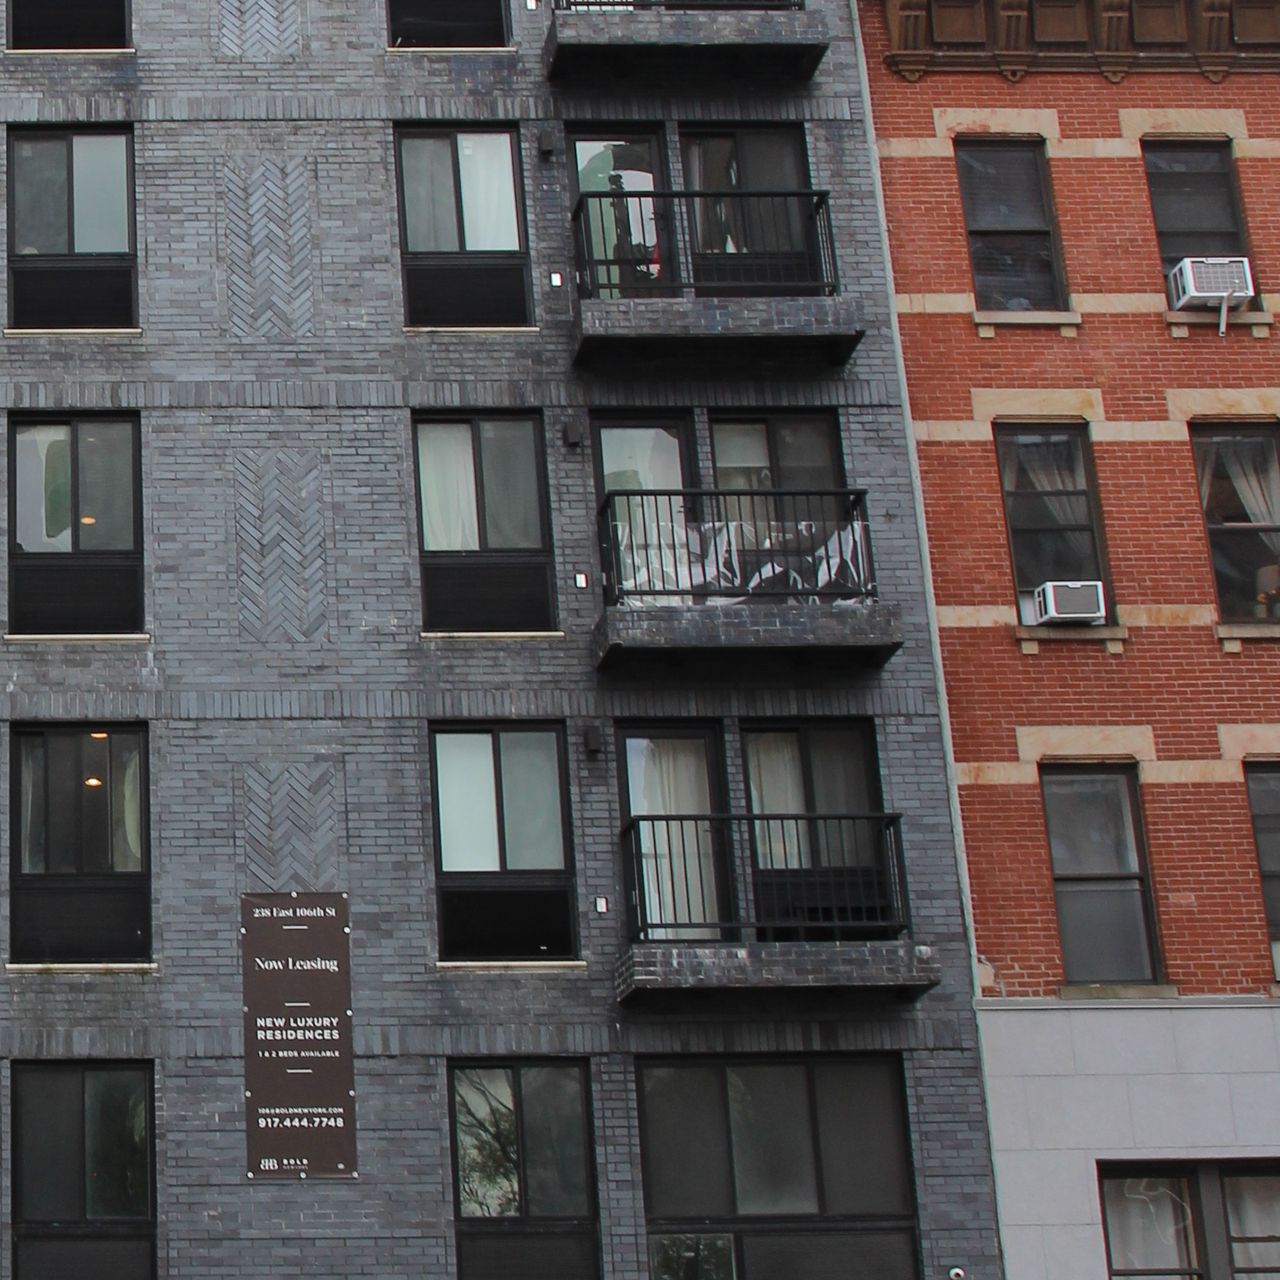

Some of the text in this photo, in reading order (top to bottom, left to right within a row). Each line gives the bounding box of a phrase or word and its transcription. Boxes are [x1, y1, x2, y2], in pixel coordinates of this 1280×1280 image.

[253, 907, 336, 917] 238 East 106th St
[255, 957, 339, 972] Now Leasing
[256, 1017, 339, 1027] NEW LUXURY
[257, 1029, 340, 1040] RESIDENCES
[258, 1117, 344, 1128] 917.444.7748
